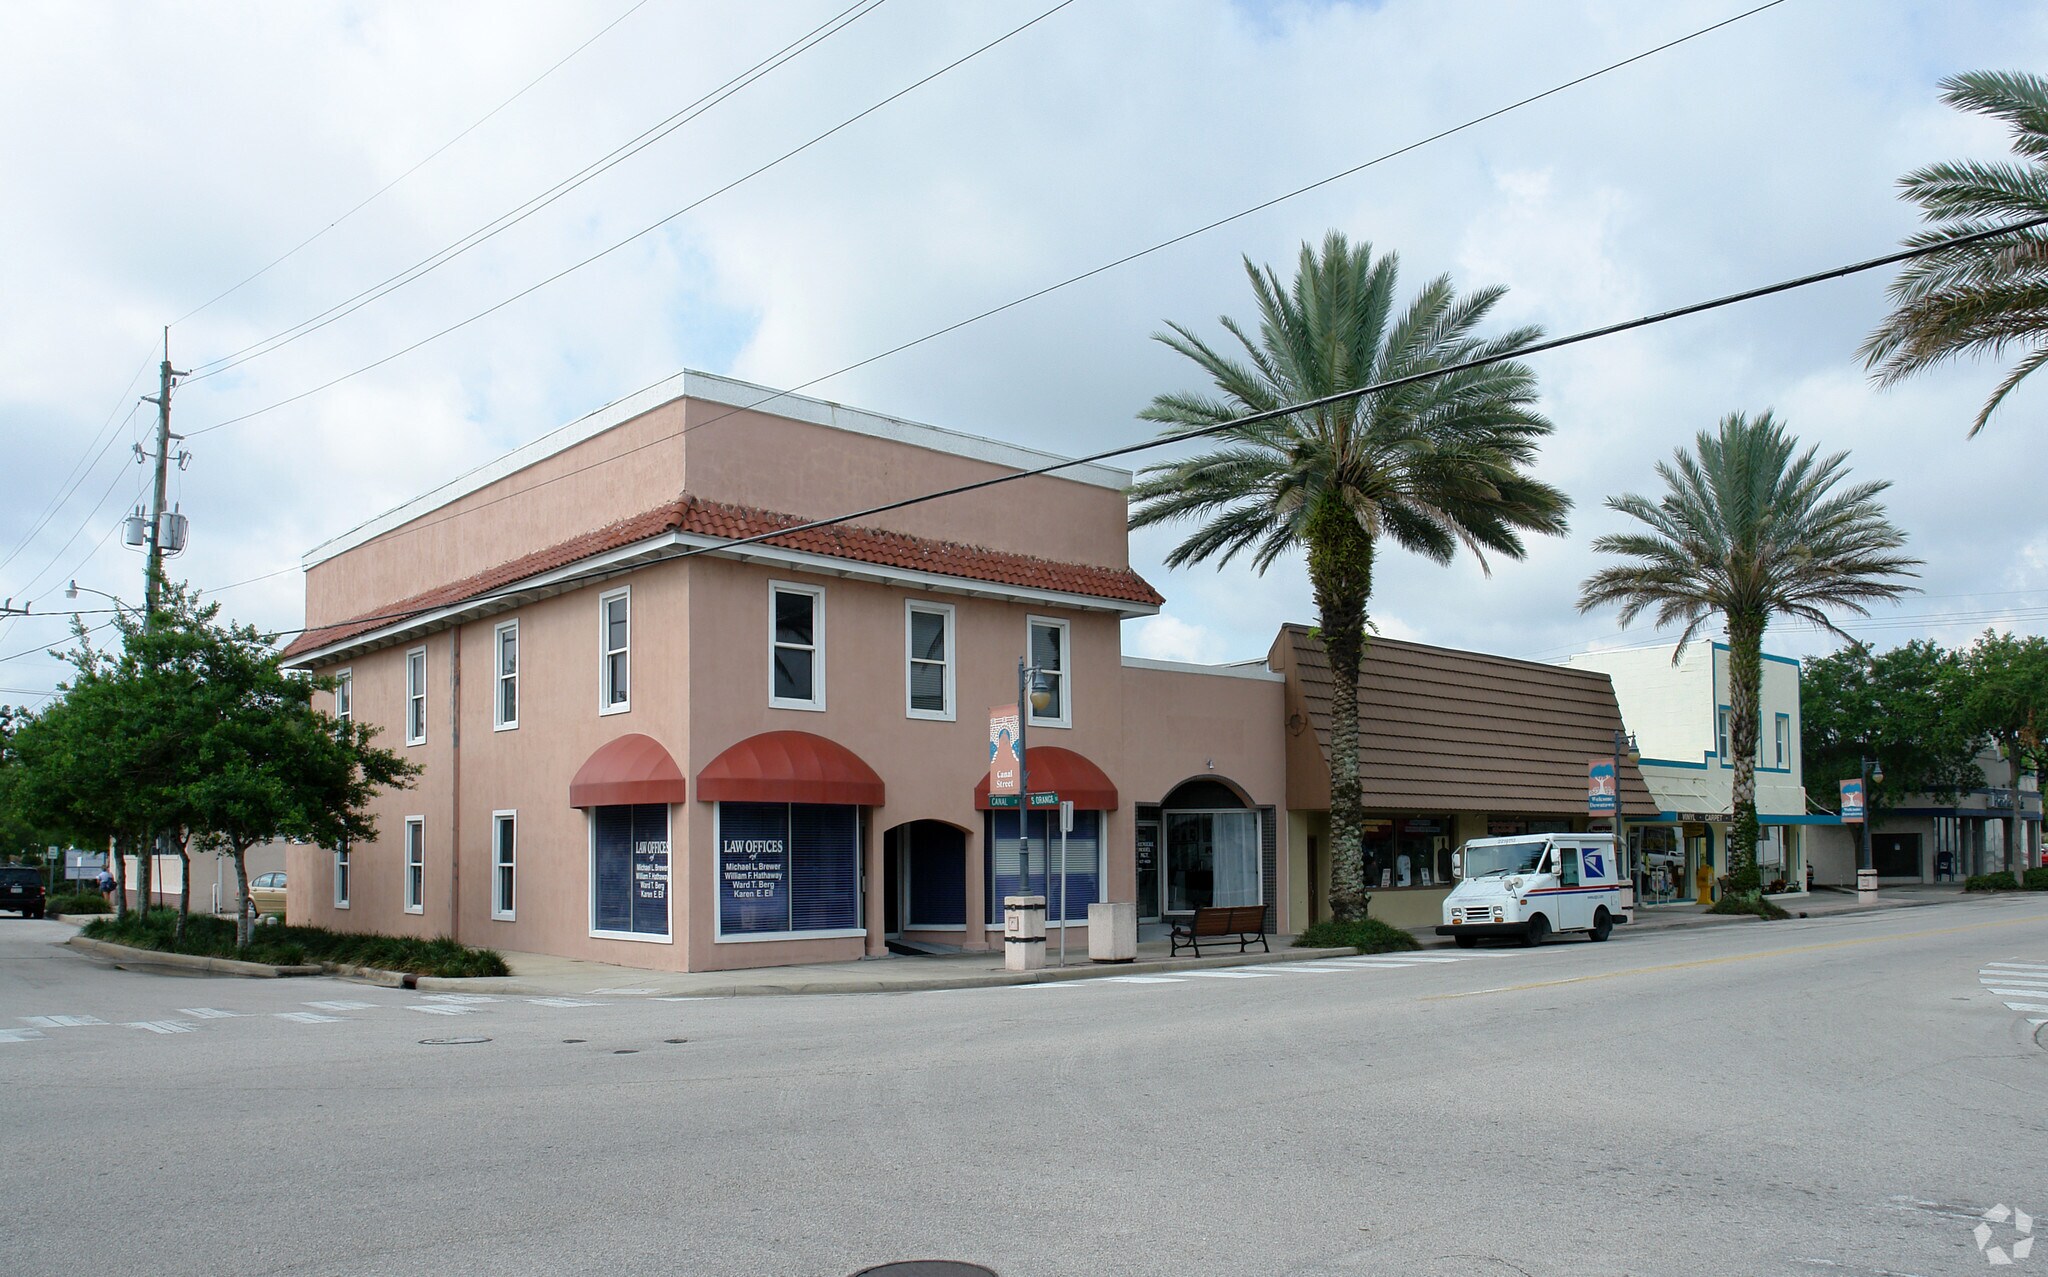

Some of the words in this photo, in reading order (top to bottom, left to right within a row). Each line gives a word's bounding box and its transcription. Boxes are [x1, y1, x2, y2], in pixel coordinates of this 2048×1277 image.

[996, 769, 1013, 779] Canal
[996, 780, 1014, 788] Street
[991, 797, 1009, 806] CANAL
[1030, 796, 1035, 805] S
[1035, 795, 1055, 804] ORANGE
[1704, 814, 1723, 822] CARPET
[635, 841, 647, 854] LAW
[724, 840, 745, 853] LAW
[745, 840, 783, 853] OFFICES
[725, 863, 751, 871] Michael
[752, 863, 758, 871] L.
[758, 863, 781, 871] Brewer
[724, 872, 747, 880] William
[748, 871, 753, 879] F.
[753, 872, 782, 880] Hathaway
[732, 881, 750, 889] Ward
[751, 881, 757, 889] T.
[758, 880, 775, 890] Berg
[733, 889, 754, 898] Karen
[756, 889, 763, 898] E.
